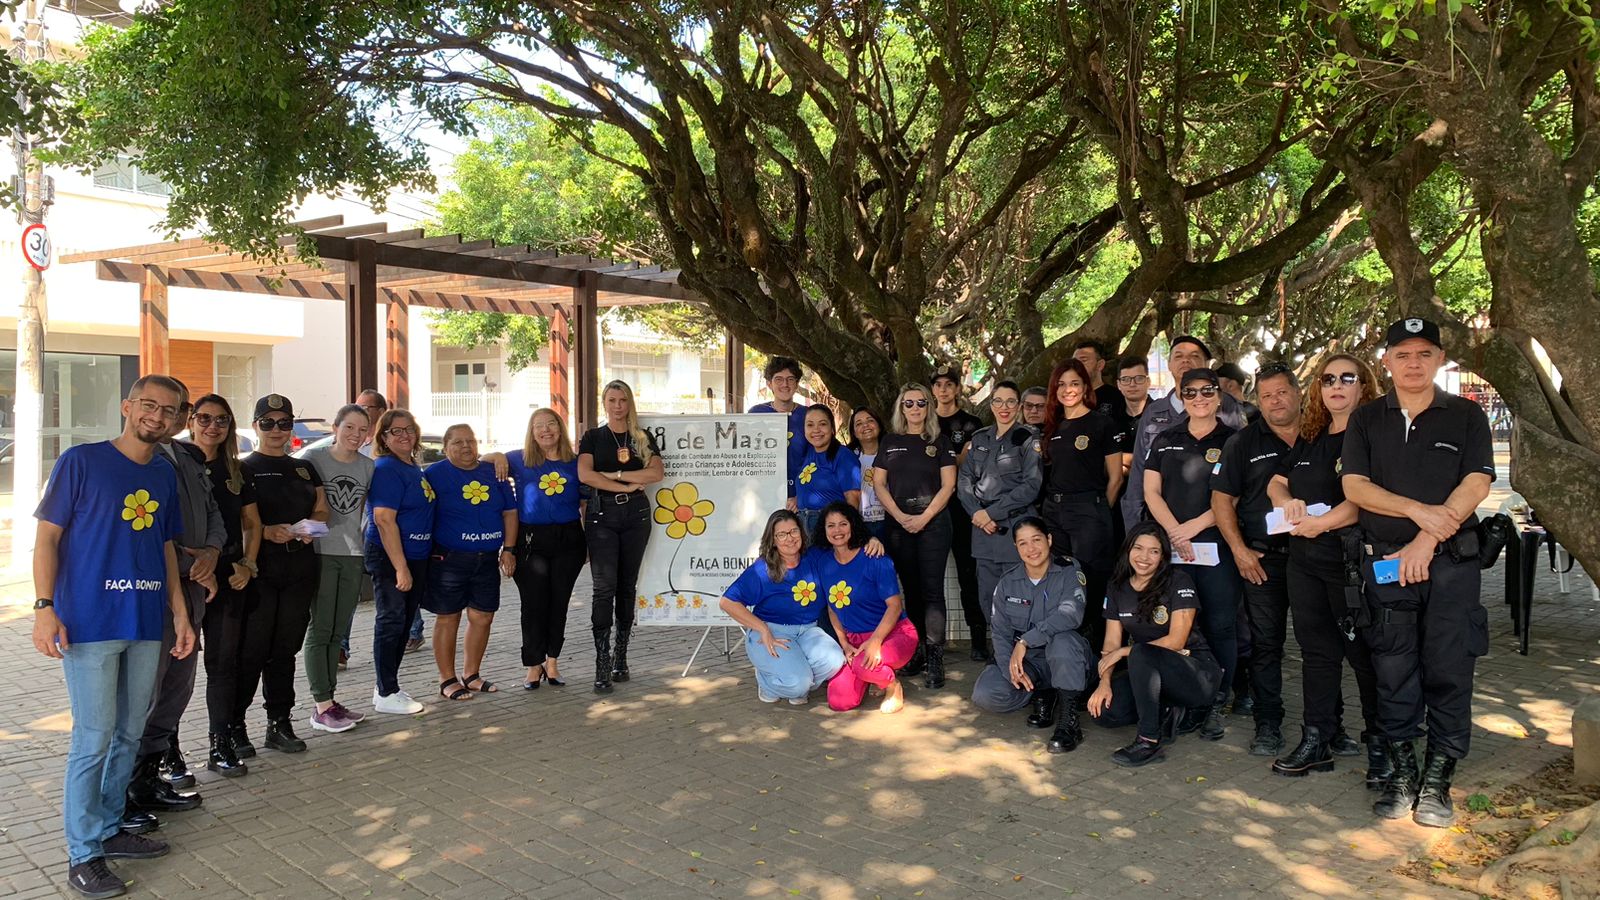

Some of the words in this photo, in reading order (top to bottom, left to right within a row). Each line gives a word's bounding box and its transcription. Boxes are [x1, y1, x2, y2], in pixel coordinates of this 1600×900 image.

[677, 432, 705, 449] de
[715, 421, 778, 450] Maio
[695, 460, 724, 469] Crianças
[731, 460, 777, 468] Adolescentes
[461, 532, 480, 542] FAÇA
[481, 531, 502, 540] BONITO
[690, 556, 720, 571] FAÇA
[723, 557, 756, 570] BONIT
[105, 579, 133, 592] FAÇA
